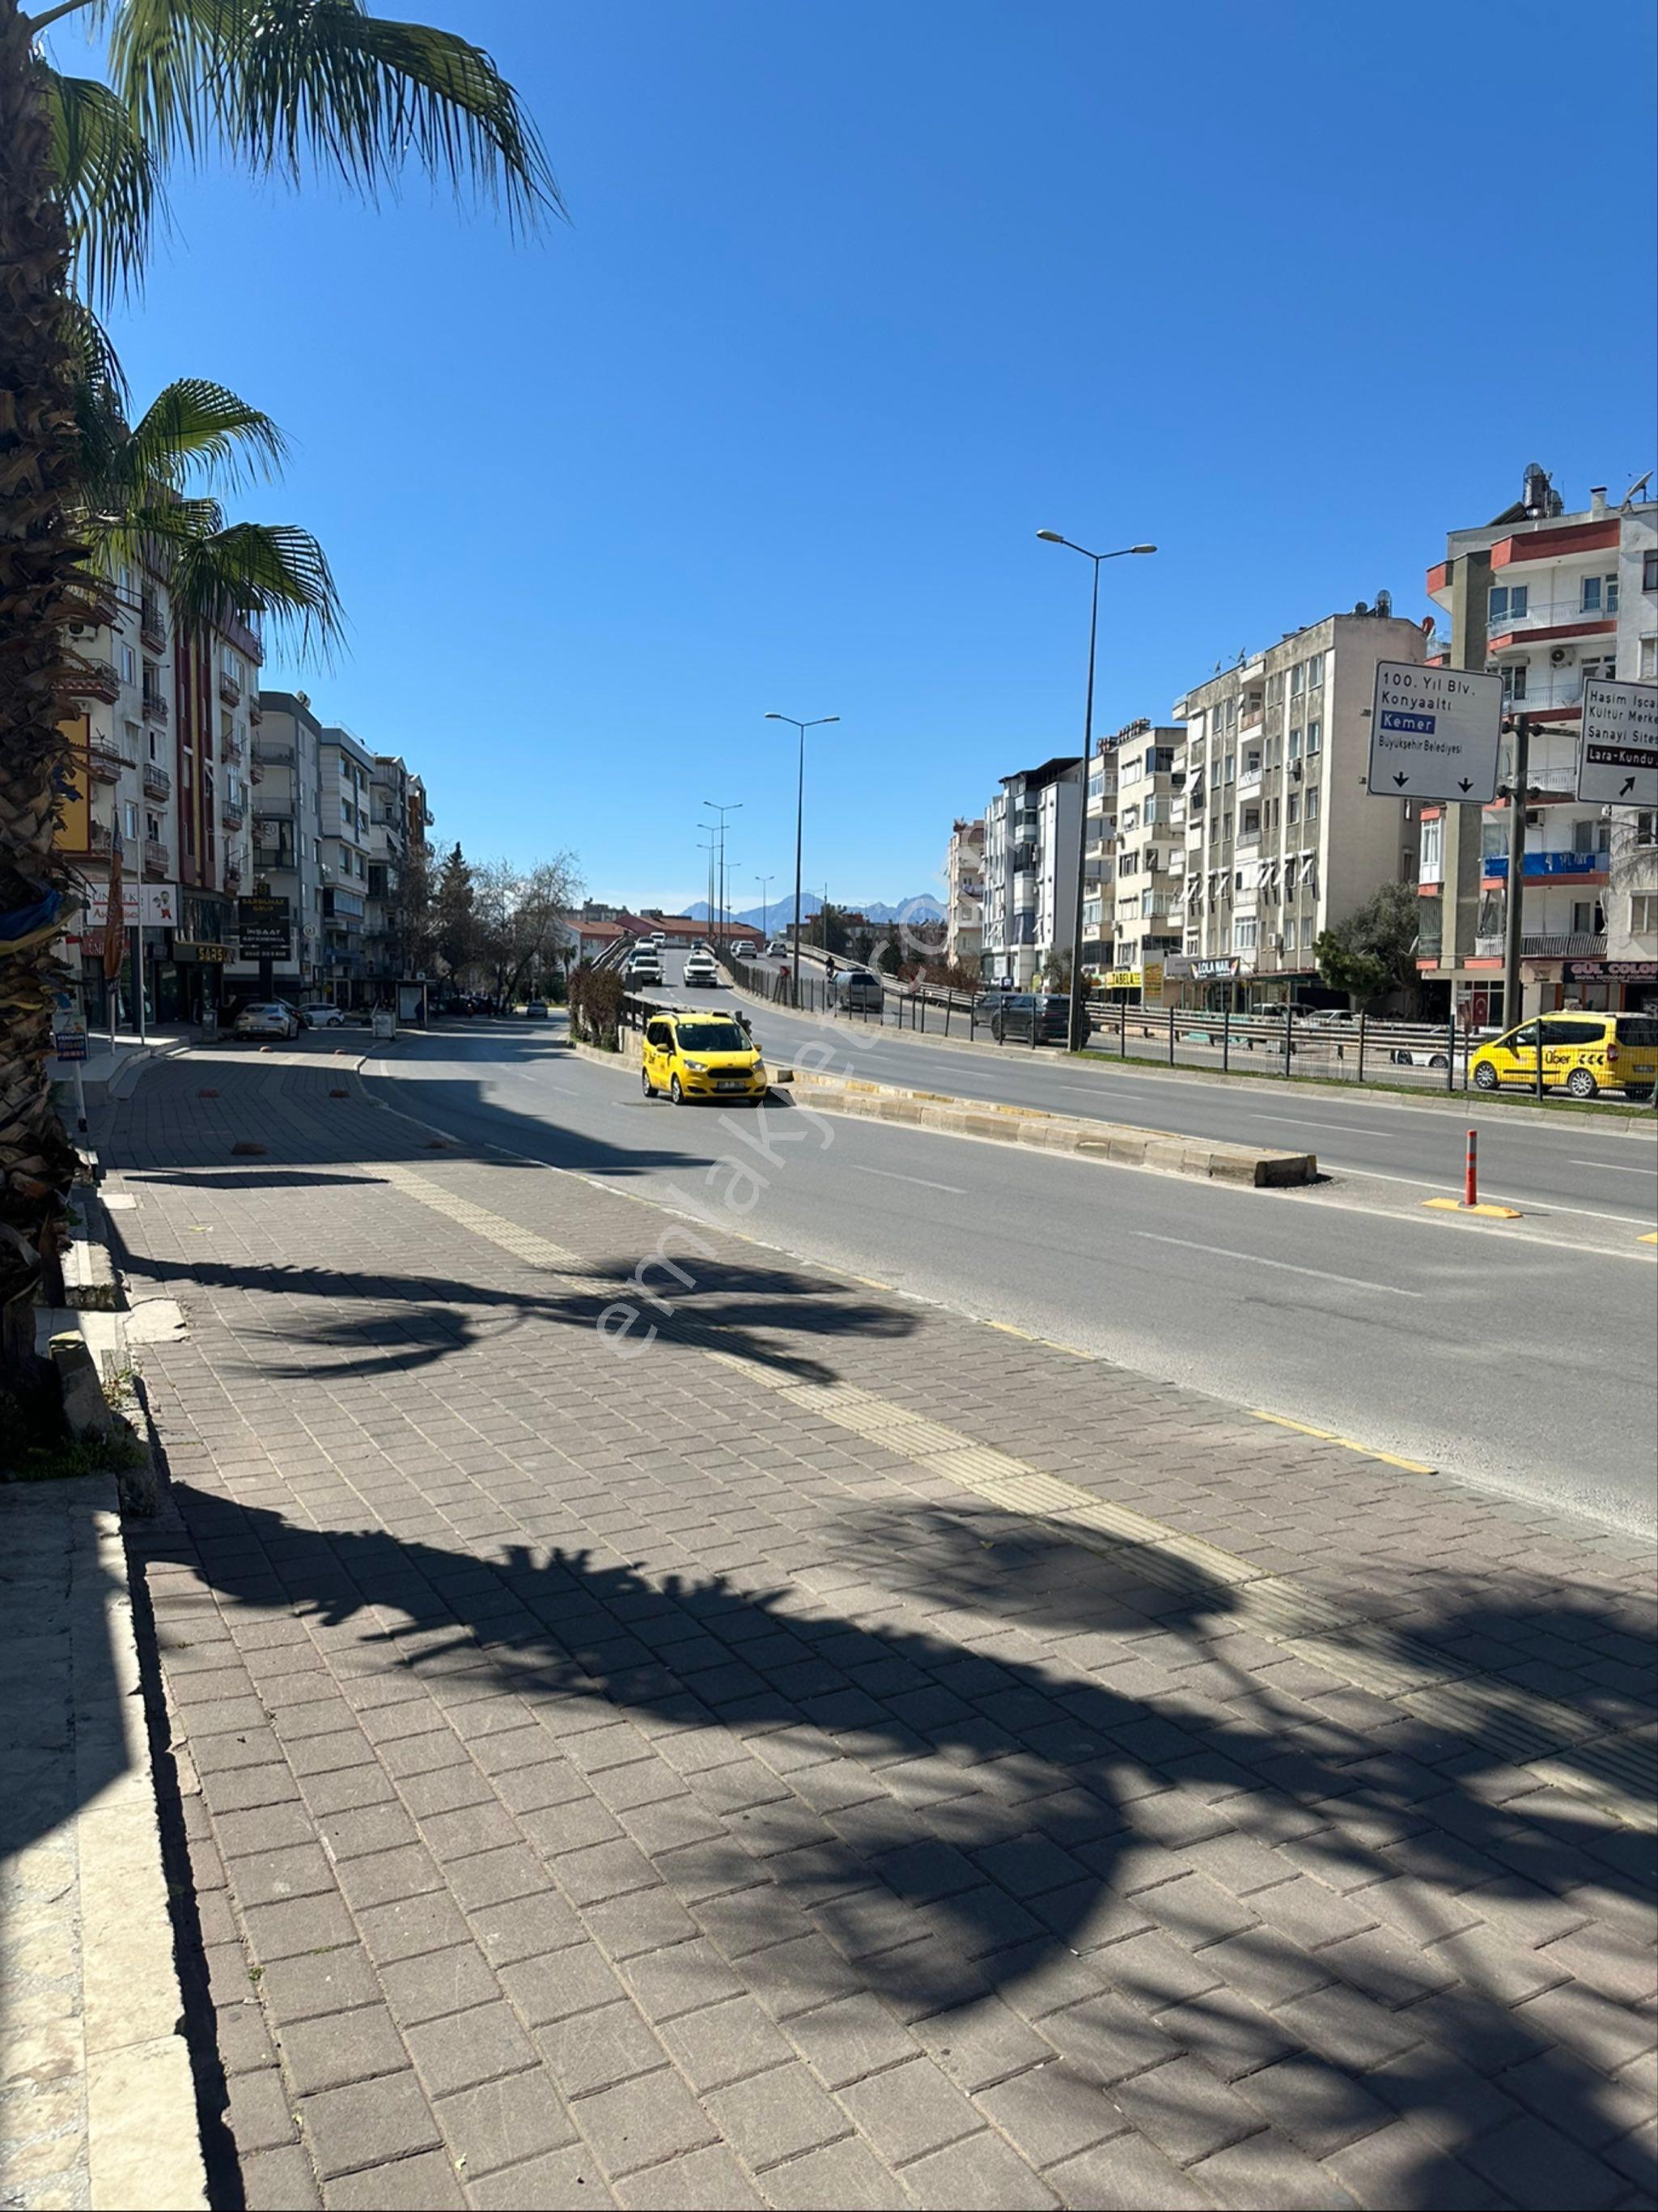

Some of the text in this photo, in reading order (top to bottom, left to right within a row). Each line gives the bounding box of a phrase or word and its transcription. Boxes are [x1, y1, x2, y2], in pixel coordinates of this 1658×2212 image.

[1384, 672, 1475, 695] 100. Yıl Blv.
[1381, 691, 1451, 711] Konyaaltı
[1384, 713, 1431, 731] Kemer
[1588, 726, 1626, 743] Sanayi
[1423, 740, 1462, 755] Belediyesi
[1589, 748, 1658, 765] Lara-Kundu
[1198, 959, 1231, 974] LOLA NAIL
[1571, 961, 1604, 975] GÜL
[1112, 973, 1134, 985] TABELA
